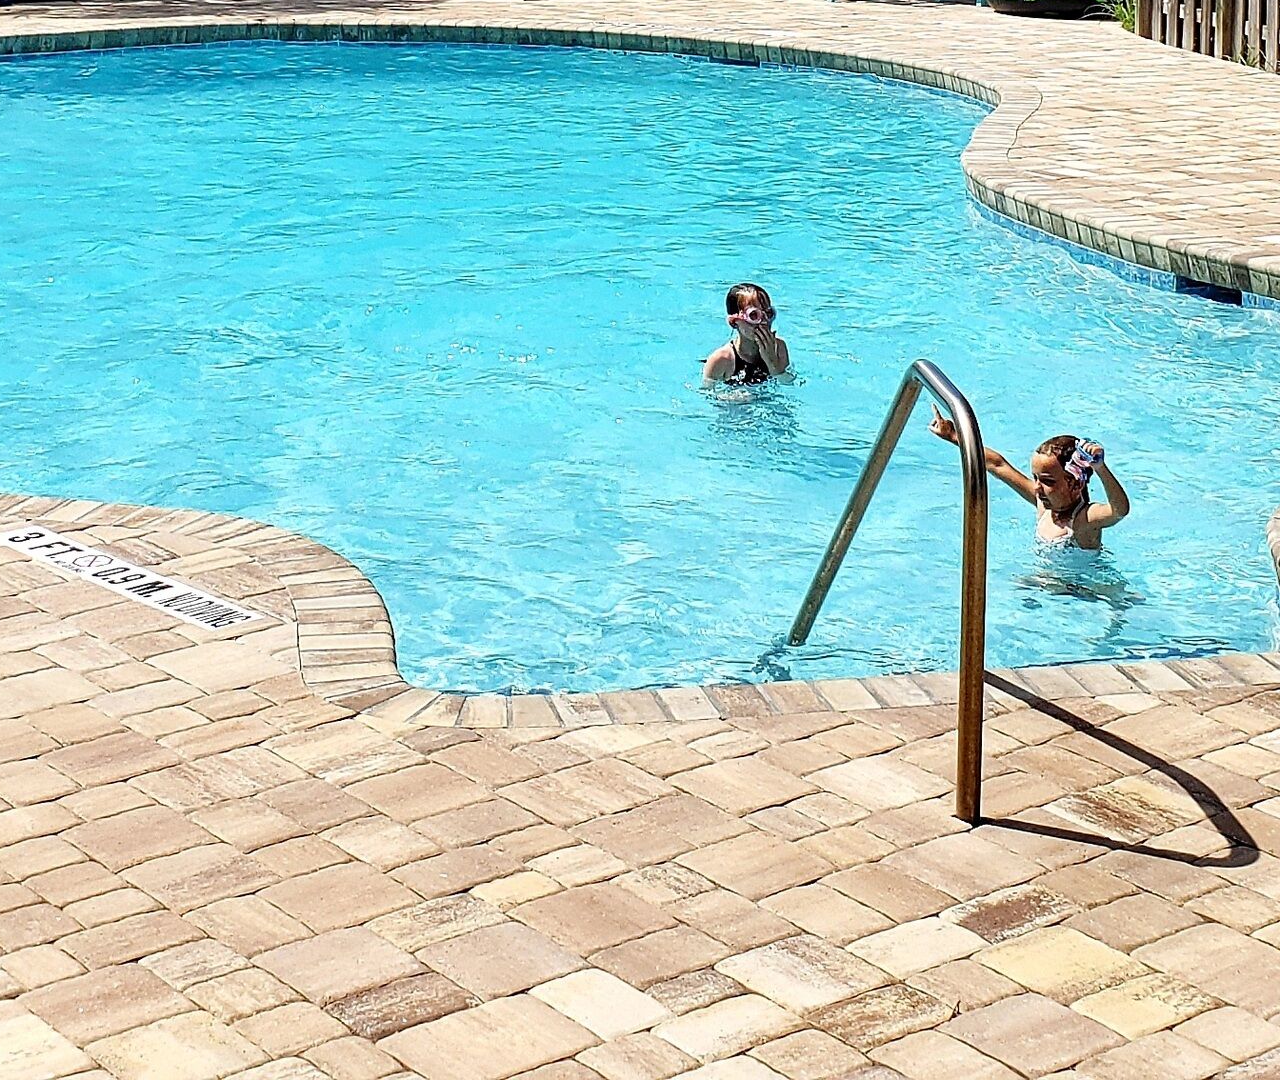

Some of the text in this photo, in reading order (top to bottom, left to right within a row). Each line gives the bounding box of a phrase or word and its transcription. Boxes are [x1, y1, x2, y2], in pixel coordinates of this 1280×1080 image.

[8, 531, 45, 543] 3
[28, 541, 84, 558] FT.
[91, 566, 147, 584] 0.9
